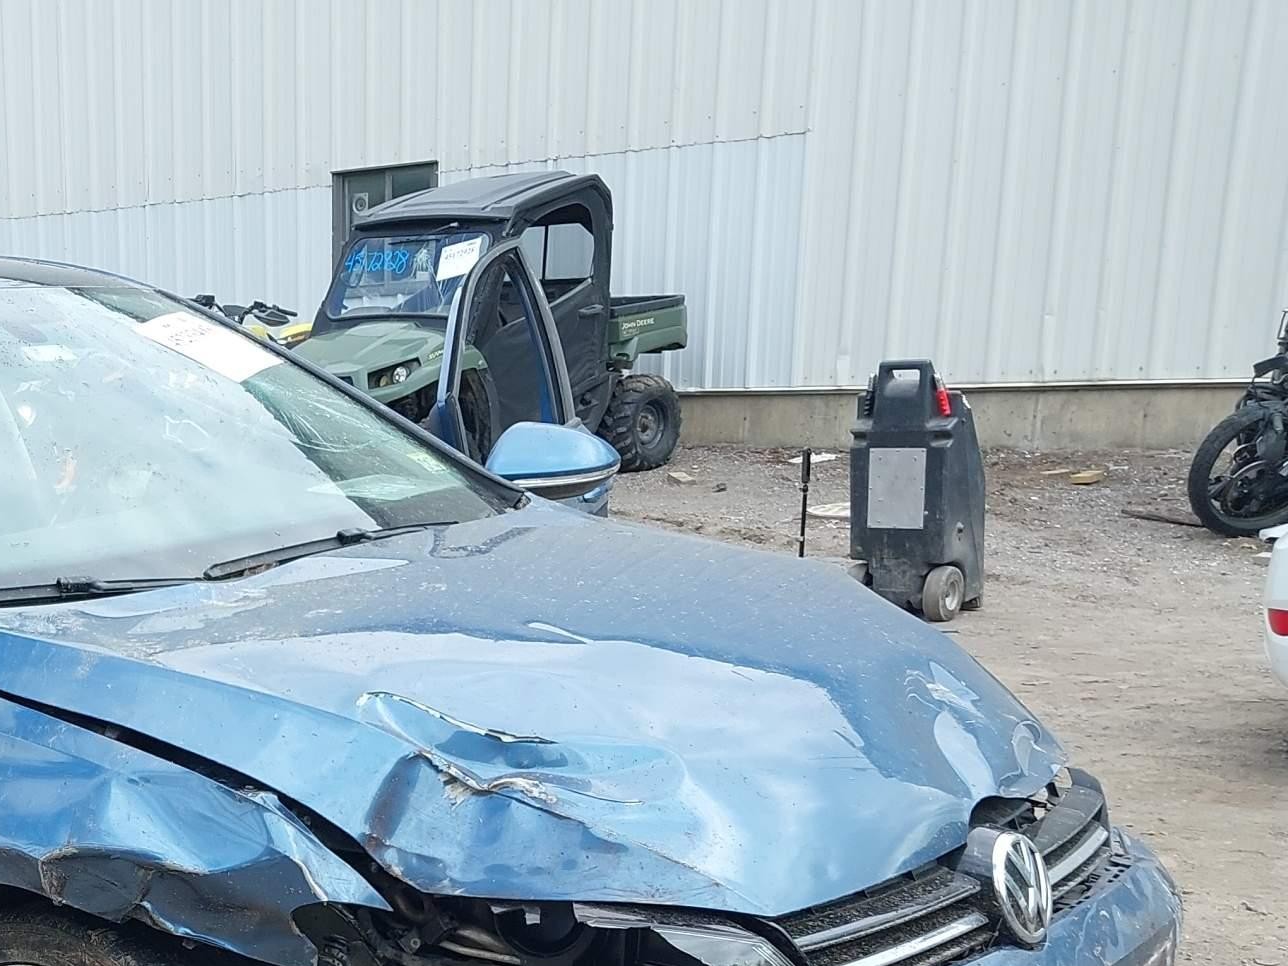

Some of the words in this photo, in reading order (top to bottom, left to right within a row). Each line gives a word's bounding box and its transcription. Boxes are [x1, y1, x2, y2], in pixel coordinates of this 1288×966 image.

[622, 321, 636, 330] JOHN
[636, 317, 655, 327] DEERE
[996, 834, 1051, 940] VW
